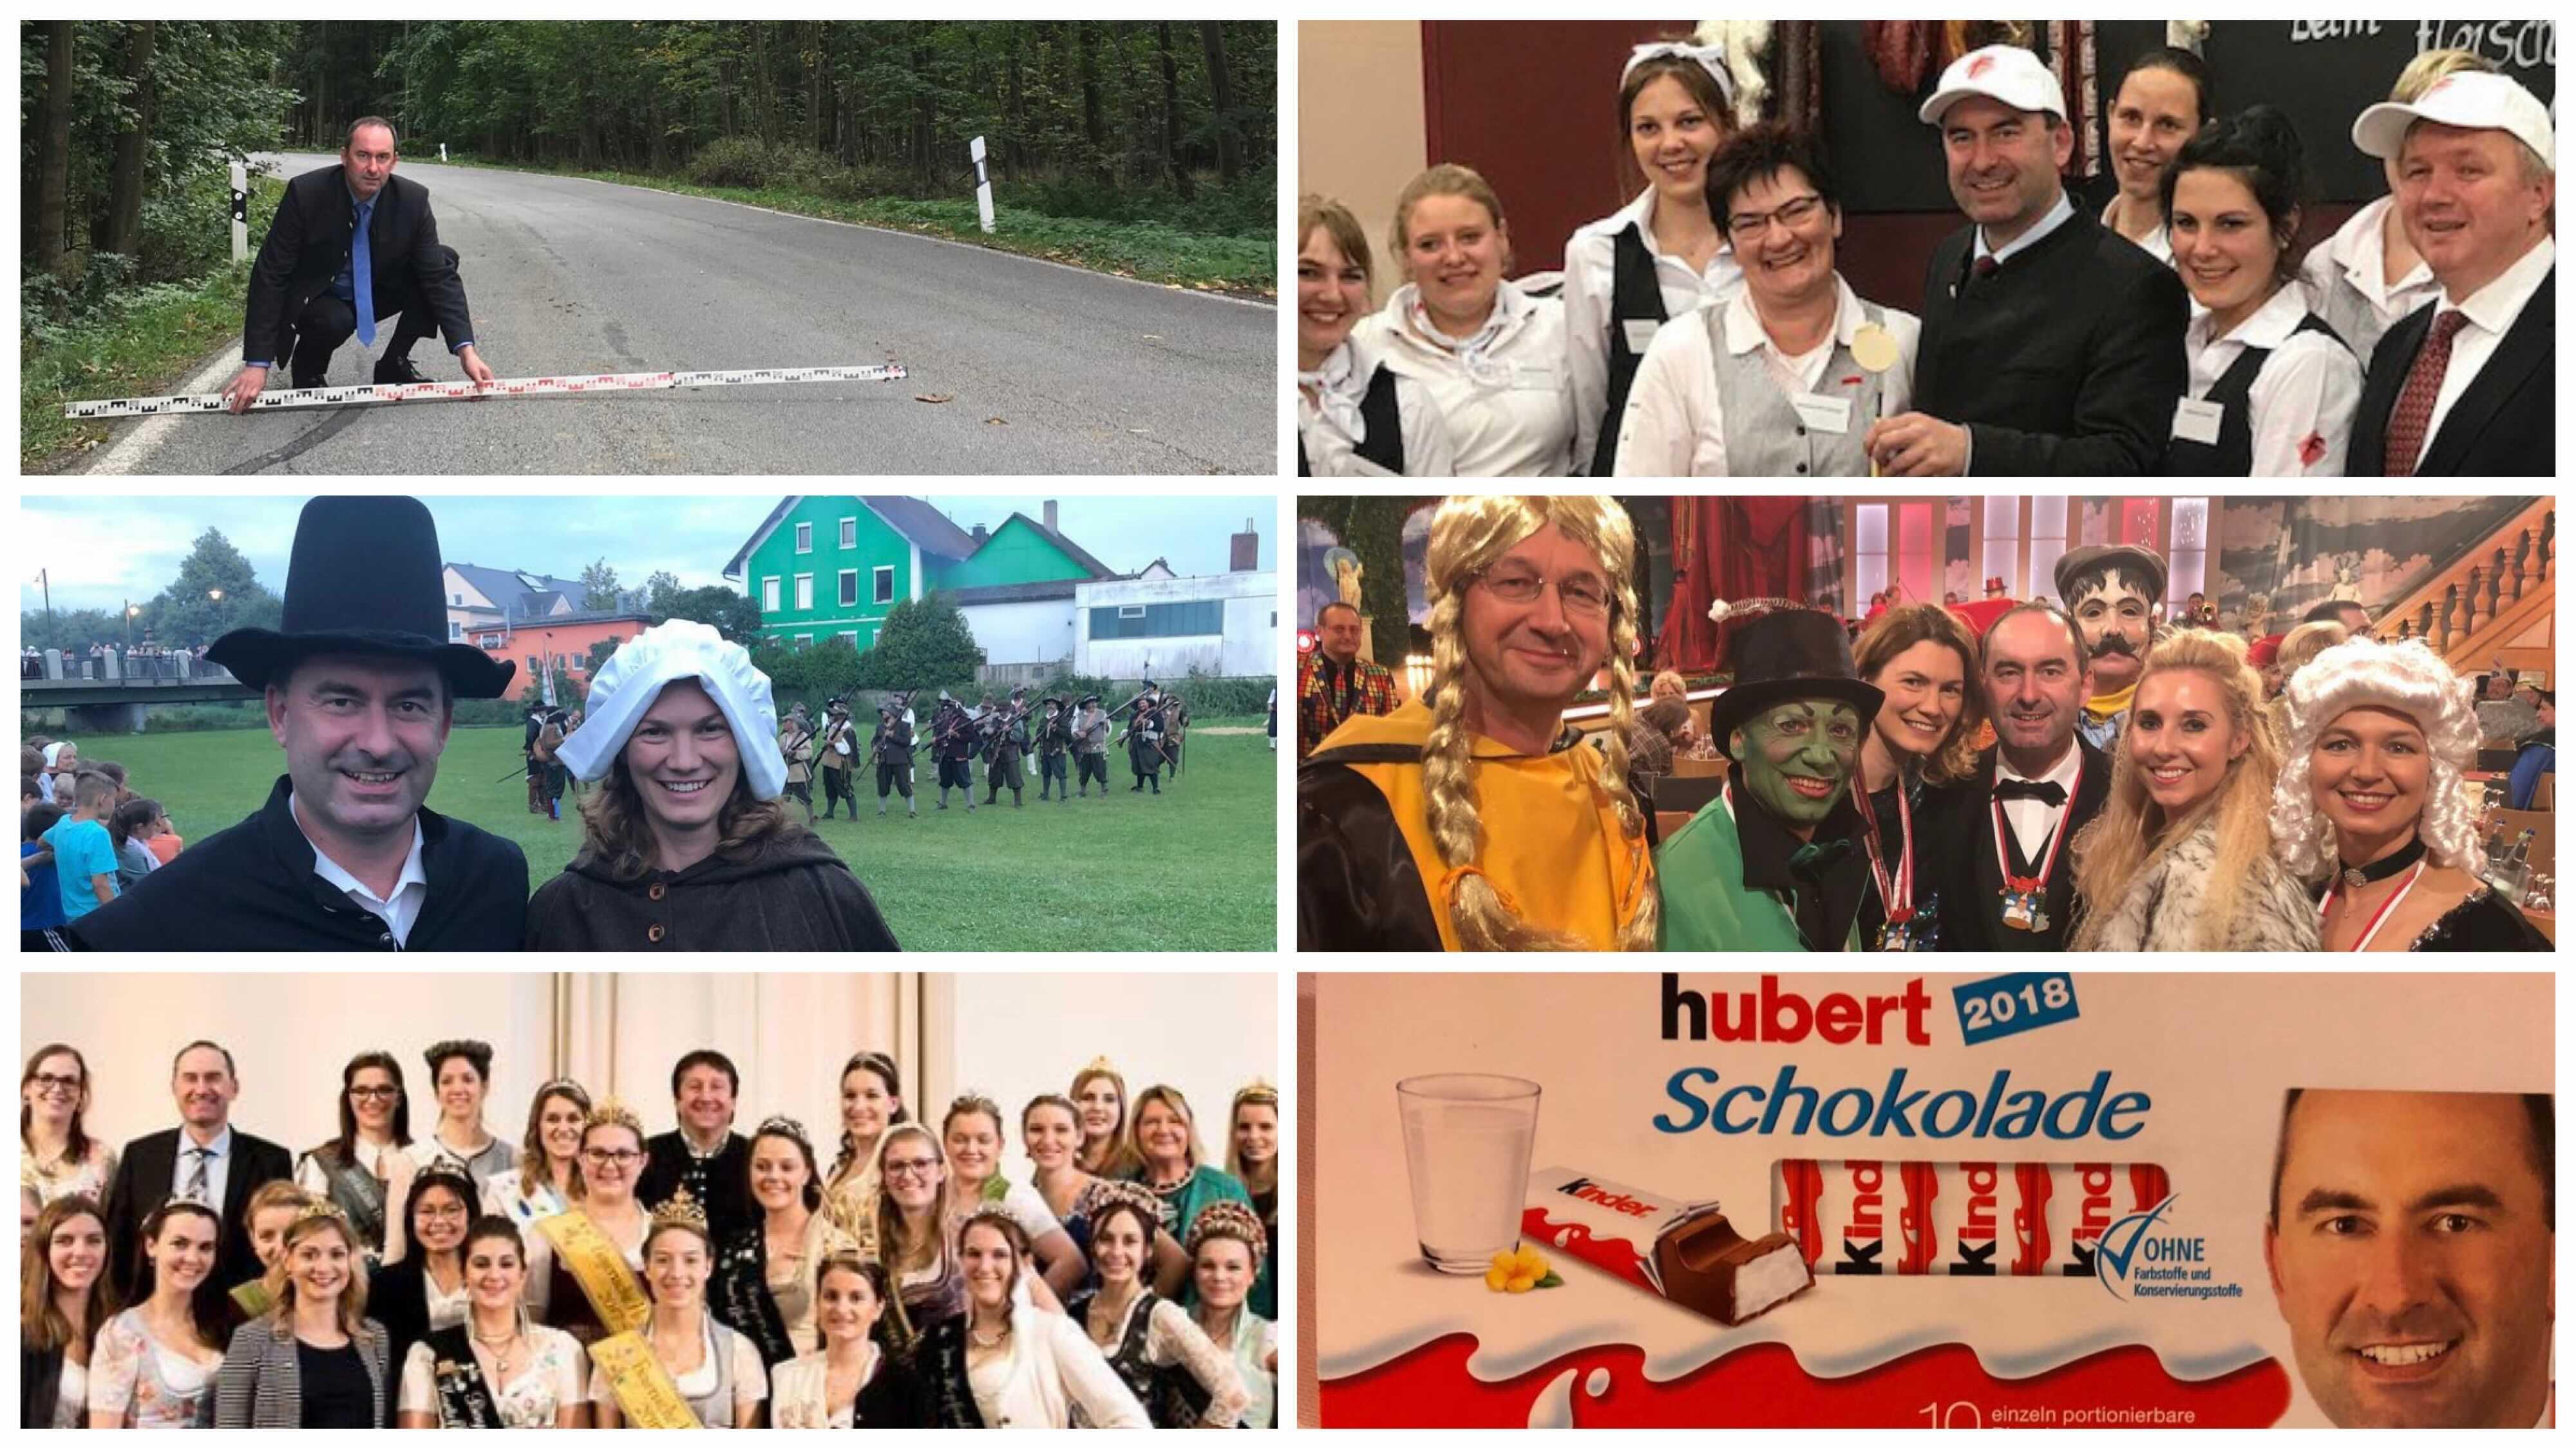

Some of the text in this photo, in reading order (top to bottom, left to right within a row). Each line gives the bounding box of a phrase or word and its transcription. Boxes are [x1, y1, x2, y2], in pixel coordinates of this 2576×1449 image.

[1661, 972, 1931, 1046] hubert
[1962, 977, 2071, 1031] 2018
[1653, 1065, 2152, 1141] Schokolade
[2144, 1237, 2204, 1262] OHNE
[2134, 1267, 2211, 1280] Farbstoffe und
[2134, 1283, 2242, 1300] Konservierungsstoffe
[1991, 1405, 2195, 1426] einzeln portionierbare
